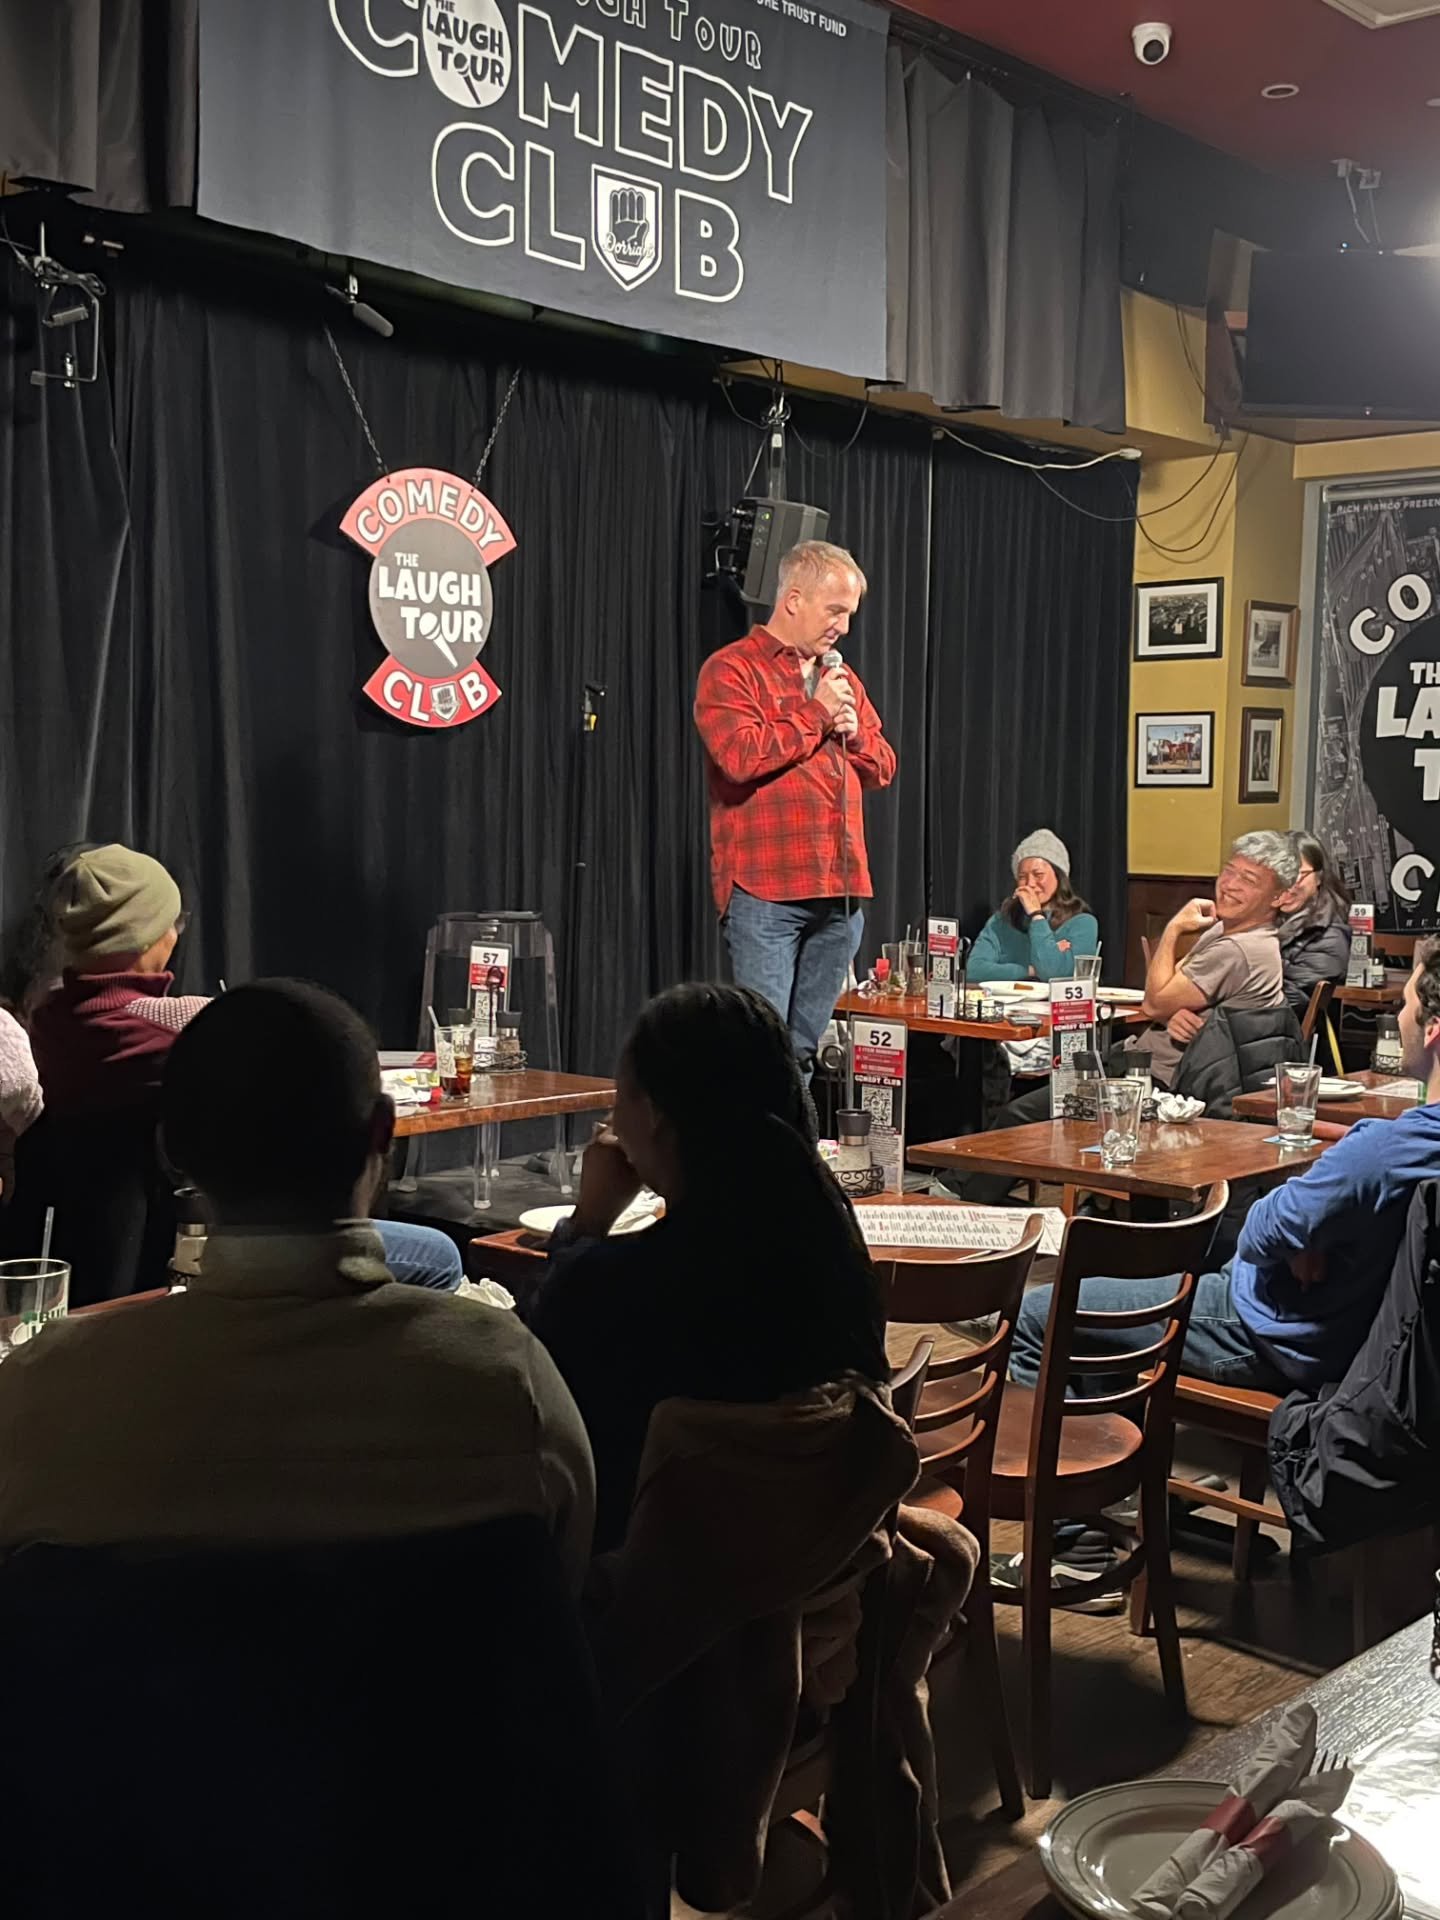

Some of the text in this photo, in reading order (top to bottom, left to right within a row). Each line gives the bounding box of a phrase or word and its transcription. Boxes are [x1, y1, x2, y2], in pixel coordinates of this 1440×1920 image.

[425, 4, 504, 58] LAUGH
[664, 0, 761, 70] TOUR
[782, 1, 817, 25] TRUST
[819, 14, 847, 37] FUND
[437, 42, 504, 88] TOUR
[356, 478, 506, 550] COMEDY
[394, 551, 419, 568] THE
[378, 565, 482, 607] LAUGH
[400, 606, 483, 644] TOUR
[382, 670, 489, 723] CLUB
[937, 924, 949, 935] 58
[1354, 907, 1366, 917] 59
[482, 952, 499, 964] 57
[1065, 986, 1083, 1000] 53
[870, 1030, 892, 1047] 52
